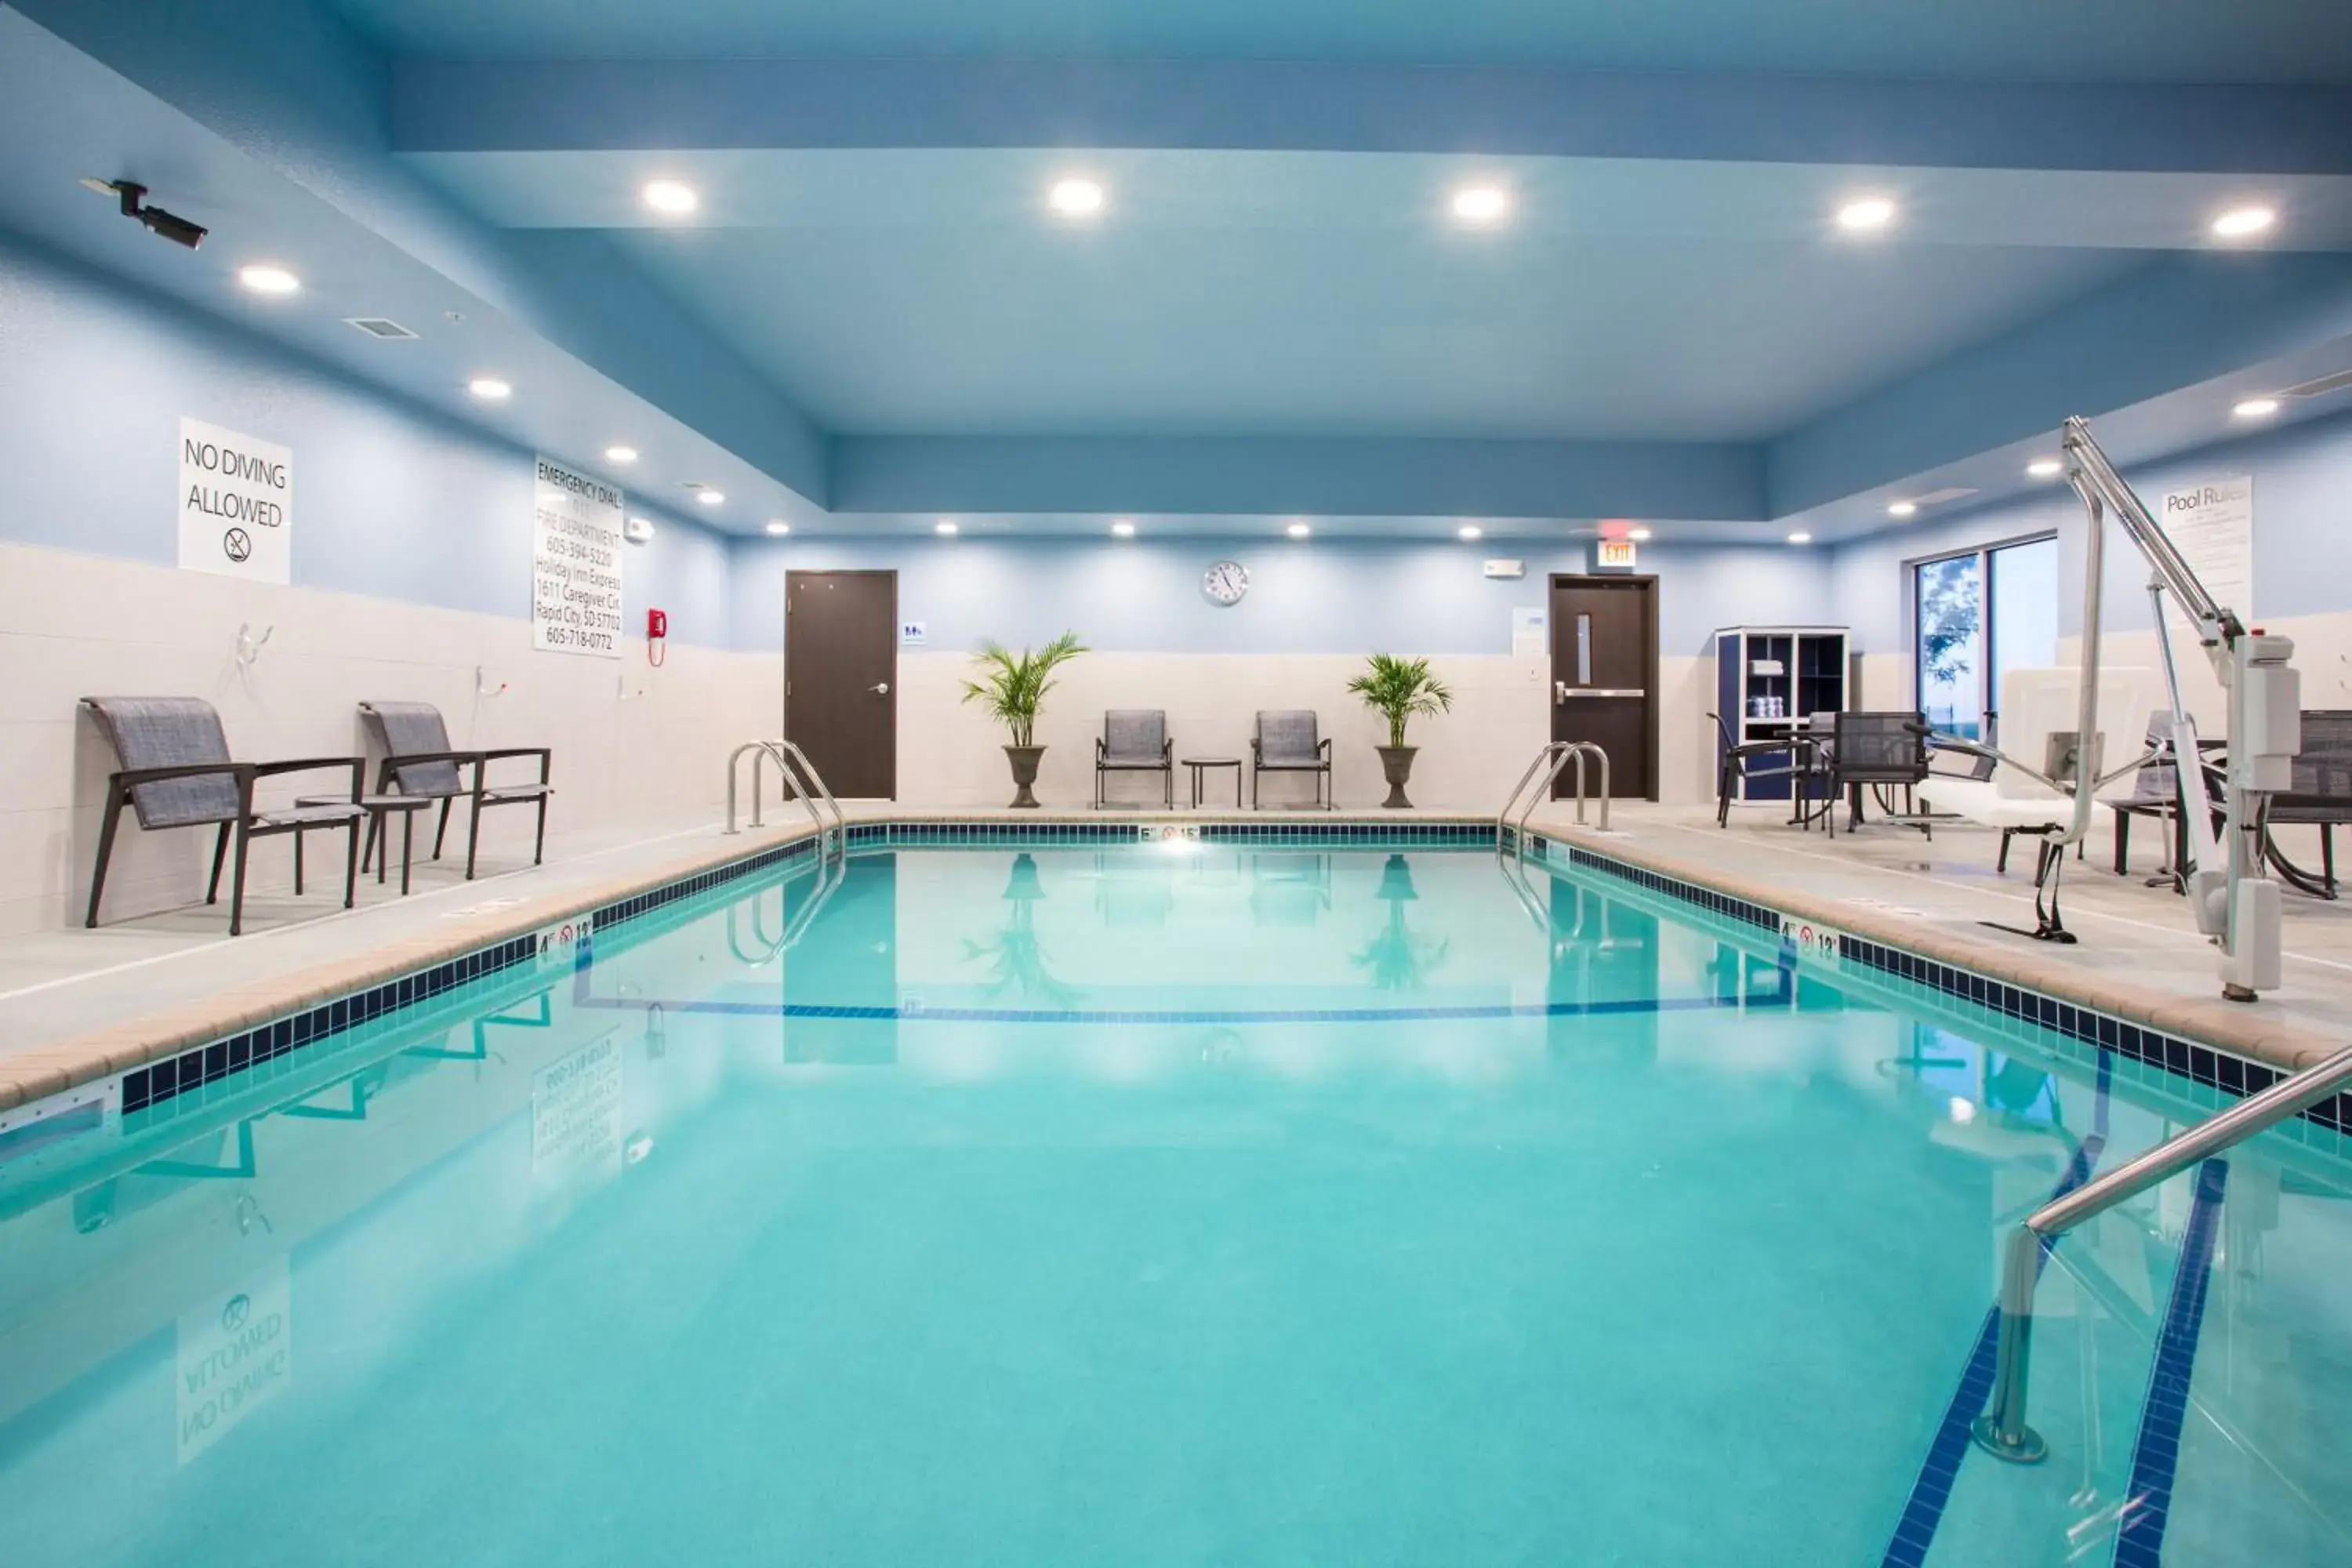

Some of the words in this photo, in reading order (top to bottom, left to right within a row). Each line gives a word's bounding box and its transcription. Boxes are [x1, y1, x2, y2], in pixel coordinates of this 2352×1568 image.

[185, 438, 218, 470] NO
[223, 448, 285, 489] DIVING
[539, 463, 597, 500] EMERGENCY
[187, 485, 281, 528] ALLOWED
[2168, 488, 2201, 513] Pool
[1606, 543, 1629, 563] EXIT
[536, 554, 571, 584] Holiday
[574, 564, 588, 583] Inn
[537, 579, 560, 598] 1611
[563, 583, 605, 609] Caregiver
[537, 600, 562, 625] Rapid
[584, 609, 595, 626] SD
[546, 626, 612, 650] 605-718-0772
